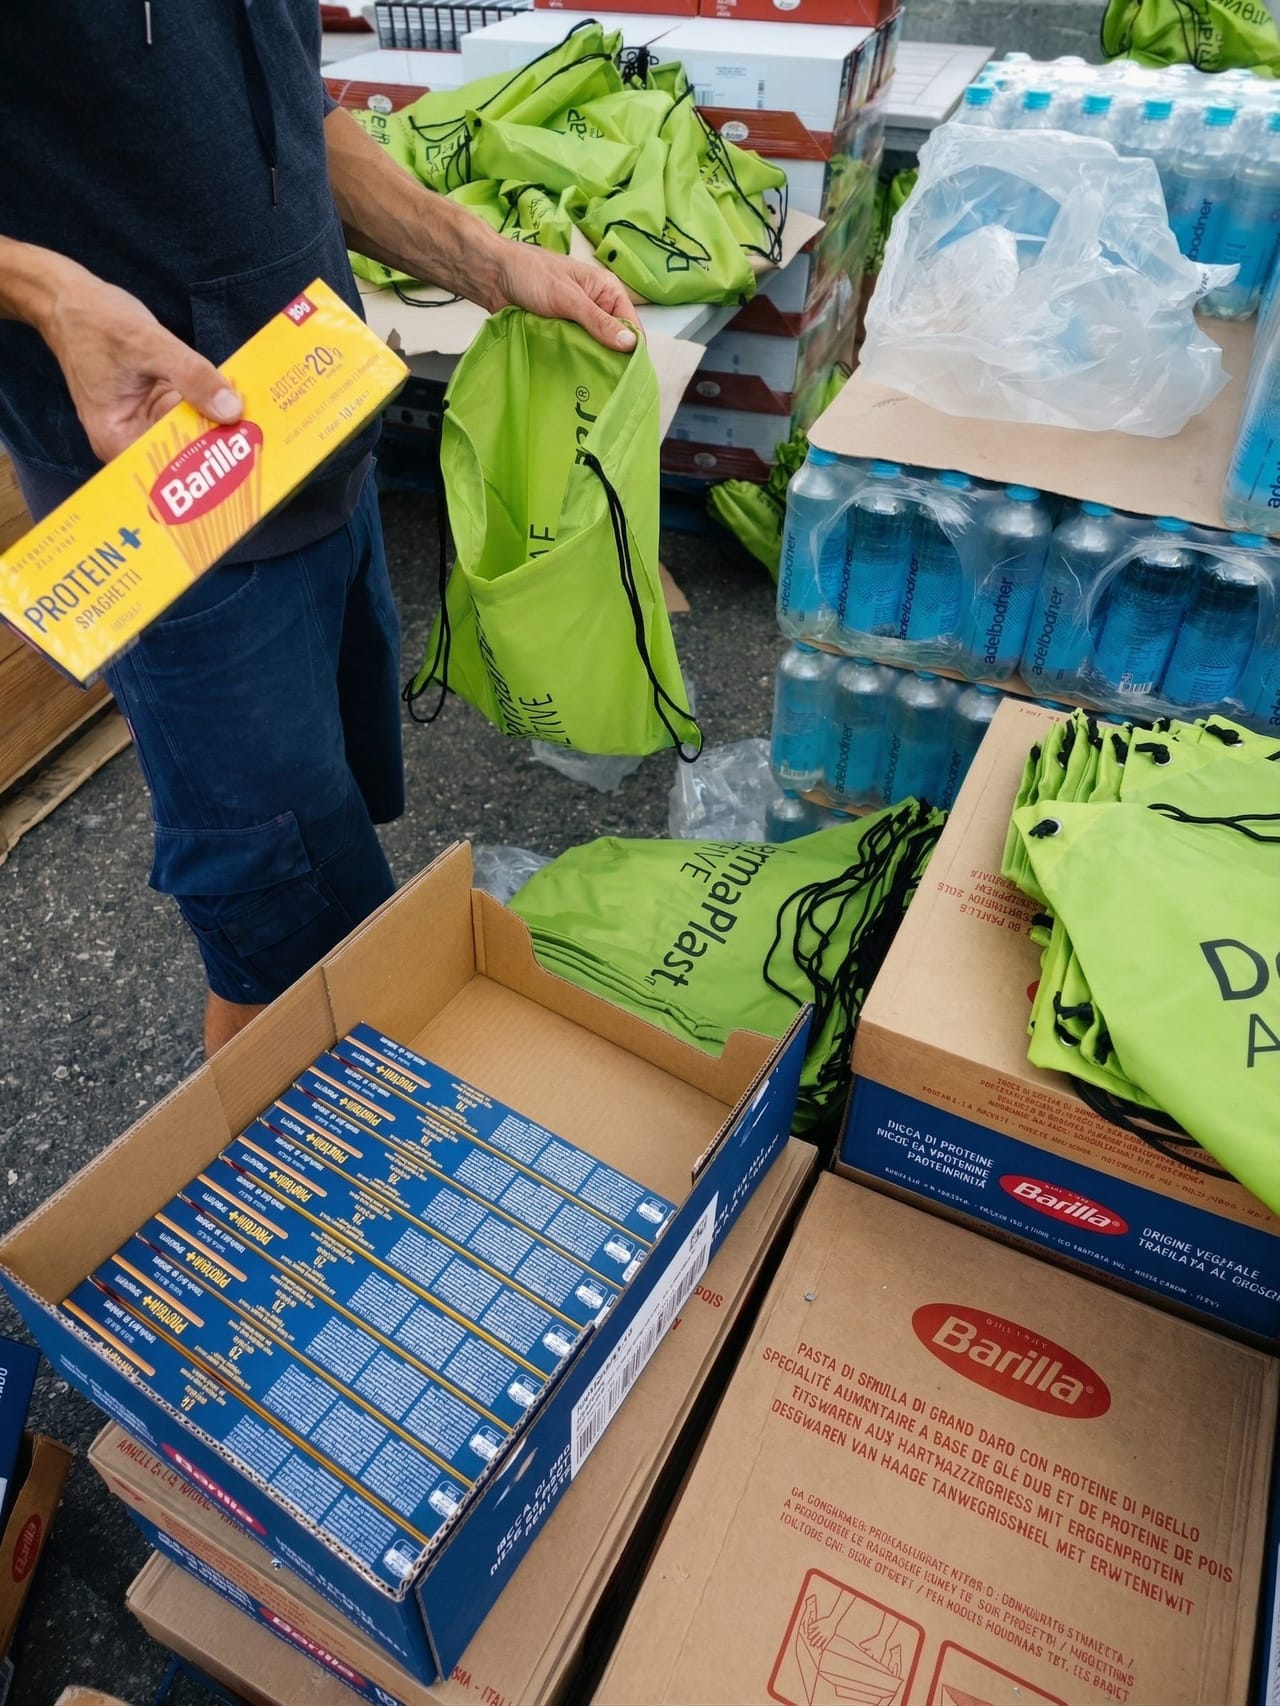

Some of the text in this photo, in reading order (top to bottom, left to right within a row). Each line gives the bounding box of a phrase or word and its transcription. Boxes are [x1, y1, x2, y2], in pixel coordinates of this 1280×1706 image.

[160, 432, 253, 519] Barilla
[75, 572, 144, 630] SPAGHETTI
[780, 532, 797, 616] adelbodner
[897, 554, 920, 640] adelbodner
[985, 577, 1015, 665] adelbodner
[1032, 586, 1065, 676] adelbodner
[925, 1133, 937, 1146] DI
[940, 1140, 994, 1169] PROTEINE
[1012, 1181, 1112, 1230] Barilla
[1209, 1267, 1227, 1281] AL
[932, 1316, 1085, 1405] Barilla
[762, 1348, 832, 1391] SPECIALITÉ
[919, 1427, 928, 1440] A
[933, 1433, 968, 1457] BASE
[972, 1450, 990, 1469] DE
[1023, 1474, 1051, 1498] DUB
[1057, 1490, 1075, 1508] ET
[1079, 1500, 1097, 1521] DE
[1102, 1510, 1168, 1554] PROTEINE
[1174, 1544, 1193, 1564] DE
[1198, 1555, 1234, 1583] POIS
[797, 1342, 836, 1371] PASTA
[841, 1364, 855, 1380] DI
[912, 1398, 926, 1414] DI
[930, 1406, 974, 1436] GRAND
[978, 1429, 1015, 1456] DARO
[1020, 1449, 1048, 1472] CON
[1053, 1464, 1118, 1506] PROTEINE
[1123, 1496, 1136, 1514] DI
[1142, 1505, 1200, 1542] PIGELLO
[852, 1438, 877, 1462] VAN
[1056, 1538, 1086, 1563] MET
[1037, 1504, 1064, 1527] MIT
